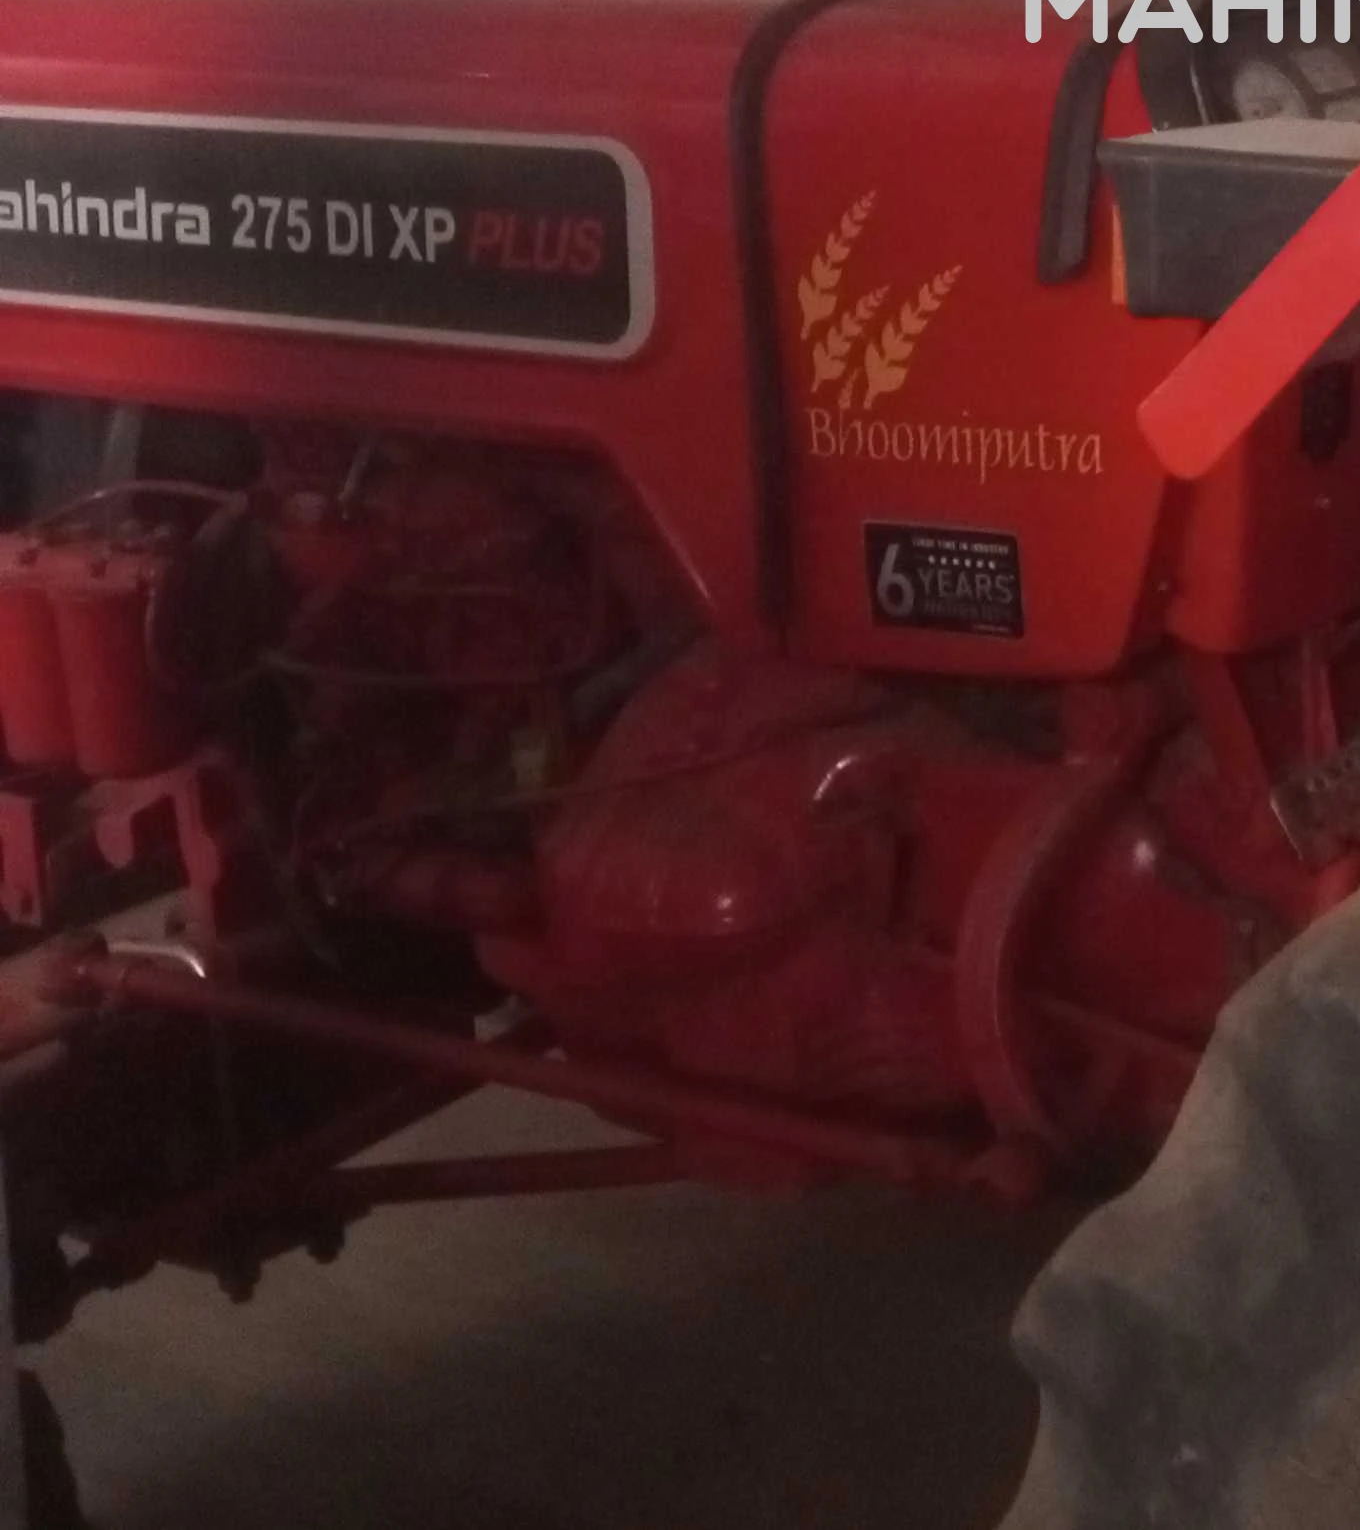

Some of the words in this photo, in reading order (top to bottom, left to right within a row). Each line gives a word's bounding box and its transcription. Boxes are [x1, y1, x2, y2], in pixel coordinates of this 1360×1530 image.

[231, 193, 312, 254] 275
[326, 200, 374, 258] DI
[388, 206, 456, 263] XP
[467, 210, 603, 275] PLUS
[805, 407, 1104, 485] Bhoomiputra
[877, 542, 915, 618] 6
